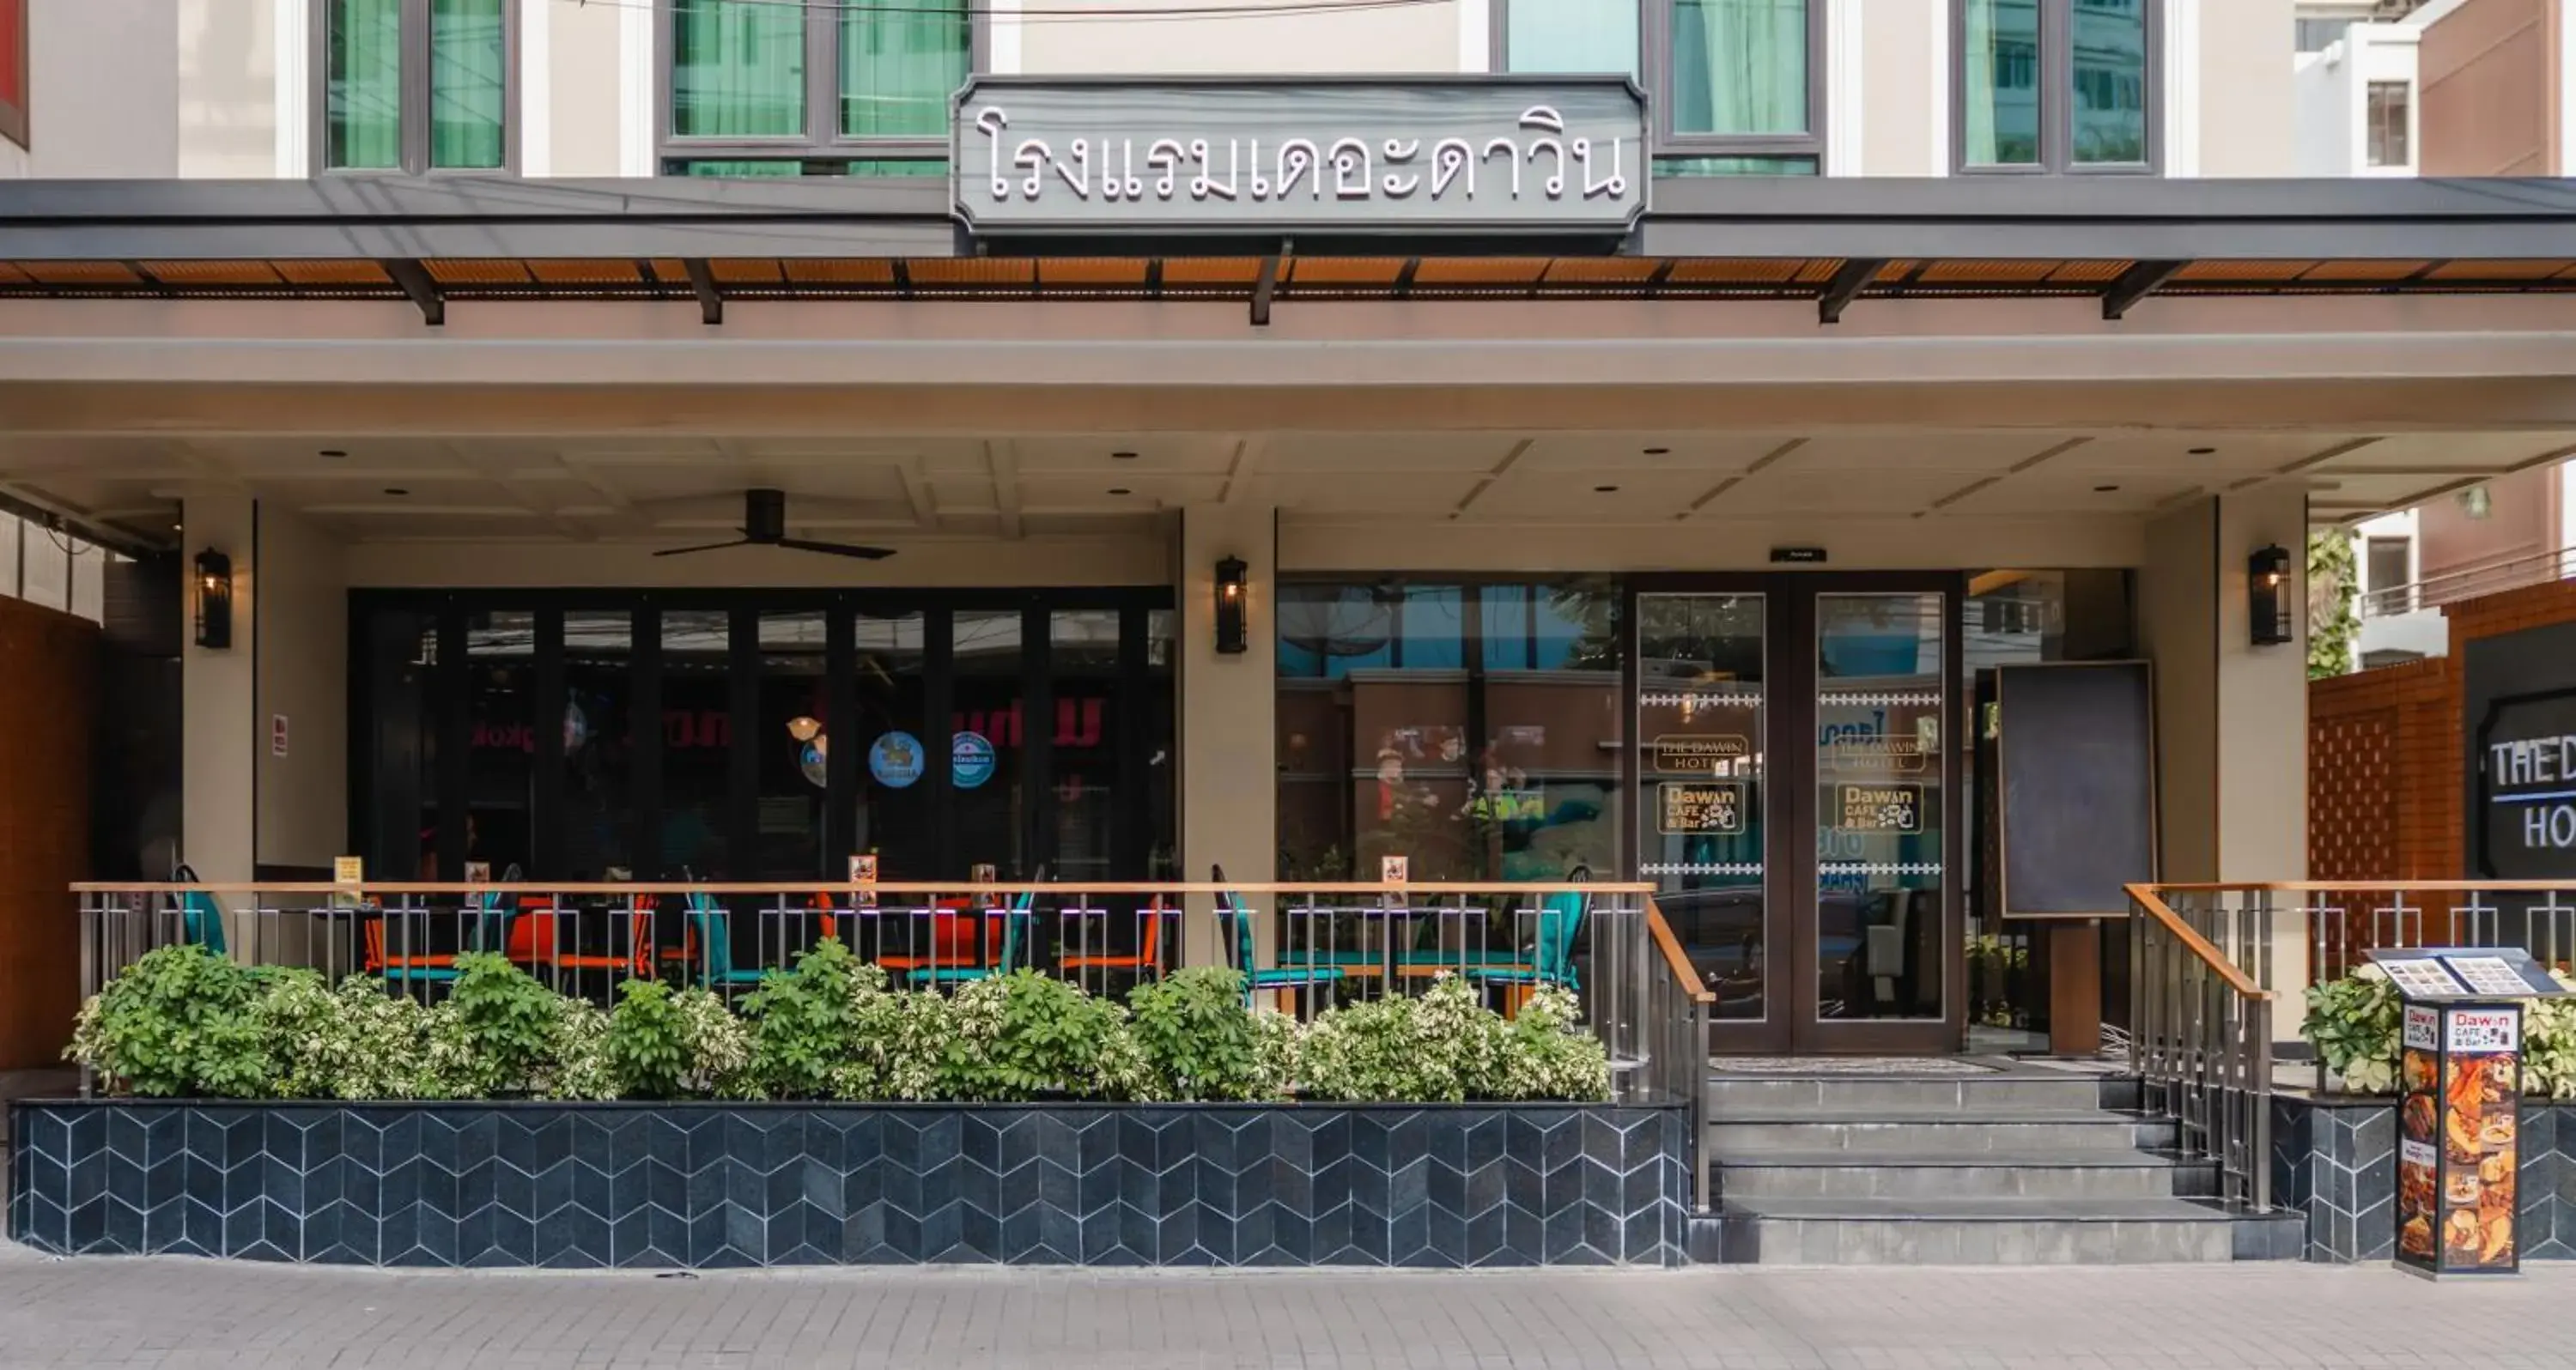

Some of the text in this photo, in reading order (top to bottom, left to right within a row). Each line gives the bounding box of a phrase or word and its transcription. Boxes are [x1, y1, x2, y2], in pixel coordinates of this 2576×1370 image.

[976, 105, 1627, 201] โรงแรมเดอะดาวิน
[1692, 742, 1742, 753] DAWIN
[2491, 736, 2560, 785] THE
[1667, 787, 1735, 803] Dawin
[1844, 786, 1913, 804] Dawin
[1668, 805, 1699, 816] CAFE
[1844, 804, 1876, 816] CAFE
[1680, 816, 1700, 828] Bar
[1857, 816, 1878, 828] Bar
[2456, 1028, 2481, 1036] CAFE
